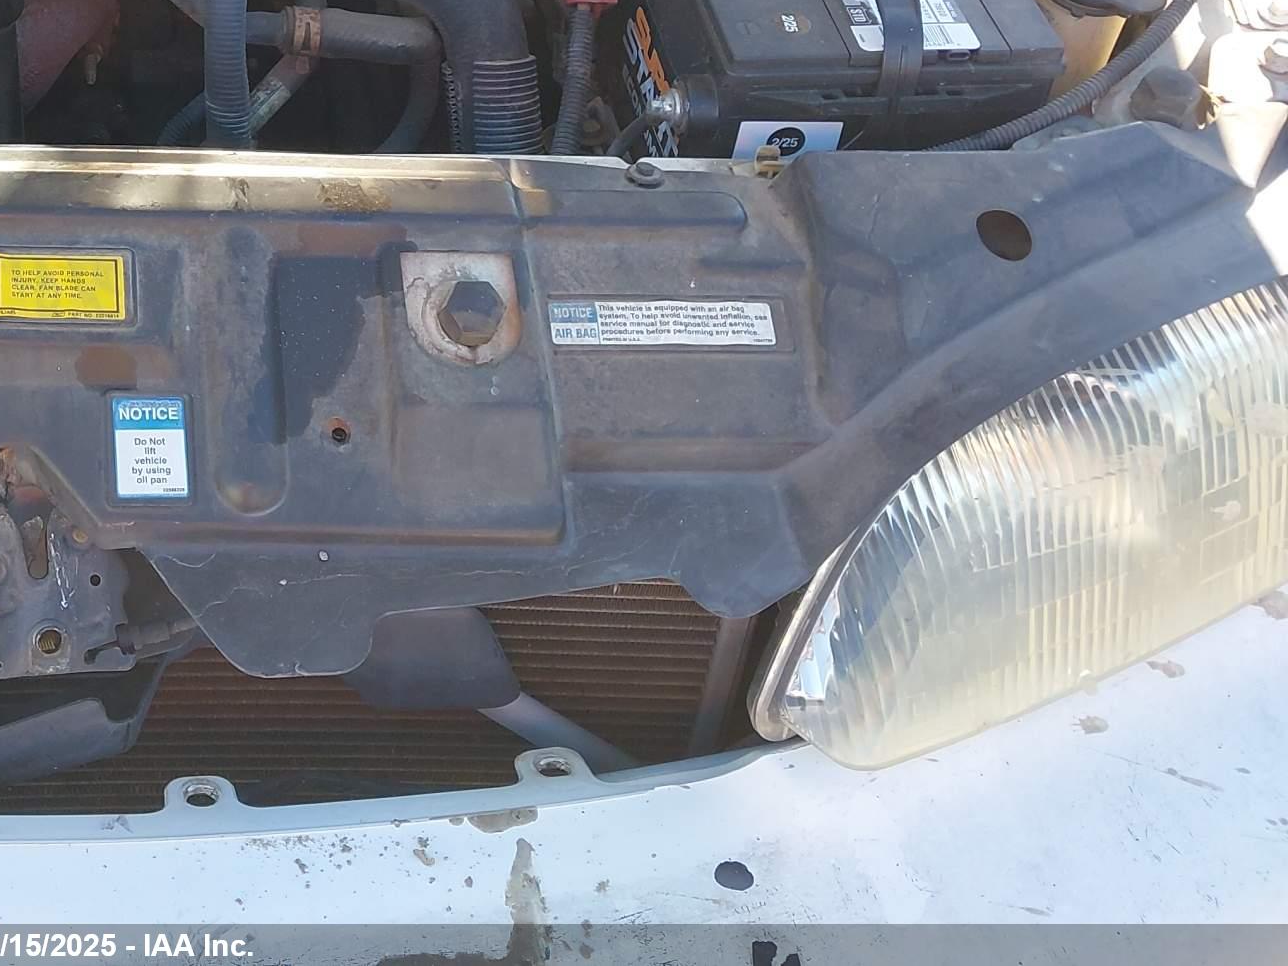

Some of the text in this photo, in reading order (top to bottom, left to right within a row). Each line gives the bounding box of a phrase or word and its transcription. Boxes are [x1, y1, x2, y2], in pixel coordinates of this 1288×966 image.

[850, 8, 867, 23] STD
[782, 14, 799, 33] 2/25
[772, 137, 800, 148] 2/25
[554, 307, 592, 318] NOTICE
[654, 305, 688, 313] equipped
[732, 306, 744, 314] bag
[672, 320, 710, 329] diagnostic
[555, 328, 597, 338] AIR BAG
[674, 328, 714, 337] performing
[119, 407, 179, 421] NOTICE
[134, 438, 166, 446] Do Not
[144, 447, 156, 455] lift
[134, 457, 167, 465] vehicle
[132, 466, 171, 475] by using
[137, 476, 168, 485] oil pan
